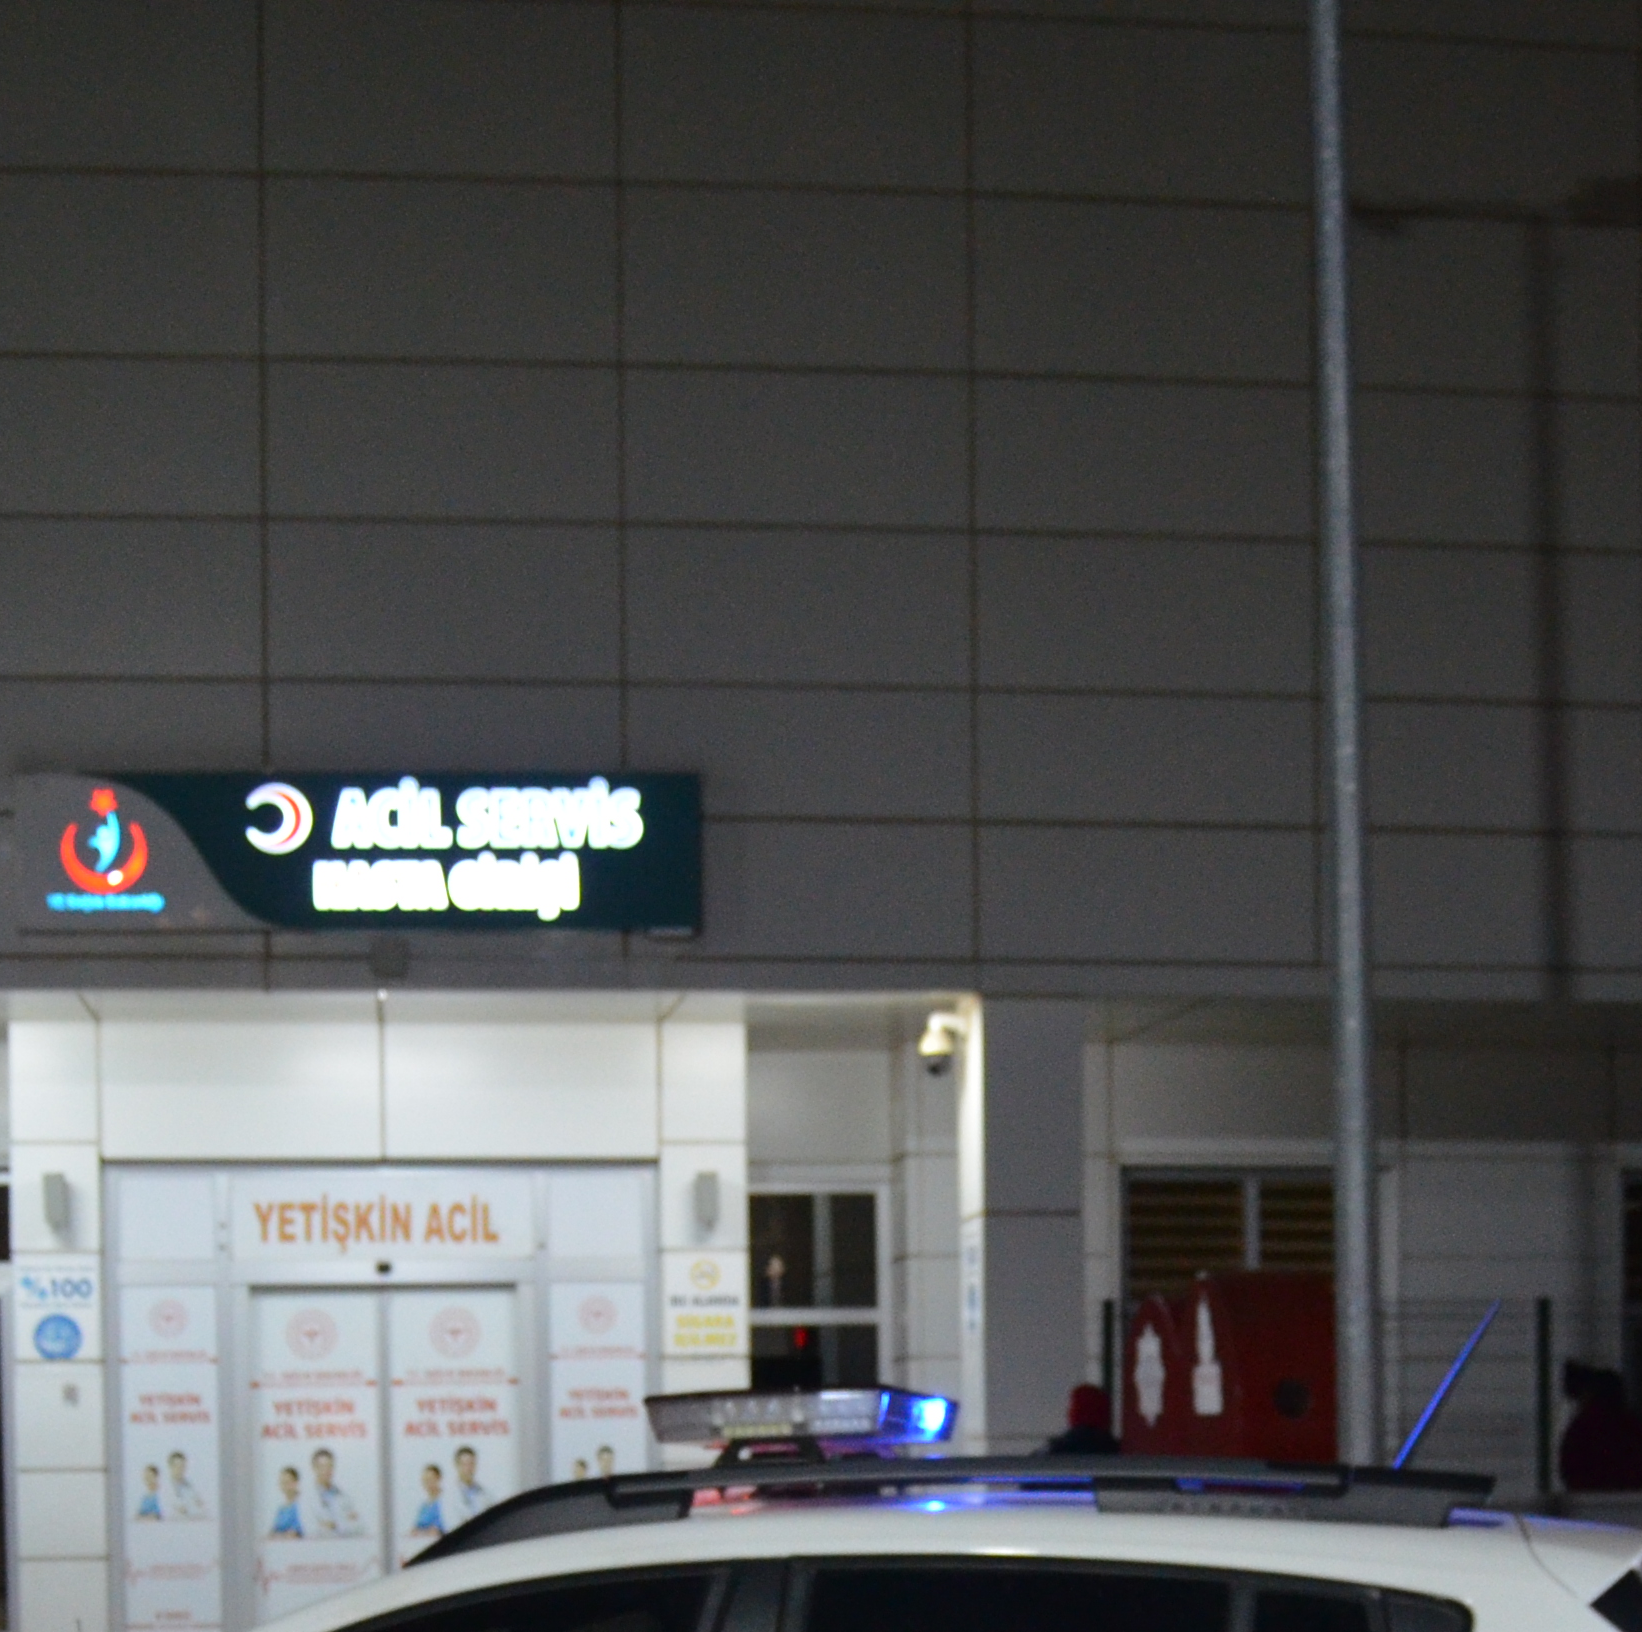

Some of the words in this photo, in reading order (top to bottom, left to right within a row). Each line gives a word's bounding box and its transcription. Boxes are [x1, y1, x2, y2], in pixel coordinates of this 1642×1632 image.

[331, 776, 454, 849] ACİL
[456, 776, 644, 849] SERVİS
[253, 1193, 412, 1253] YETİŞKİN
[424, 1193, 499, 1243] ACİL
